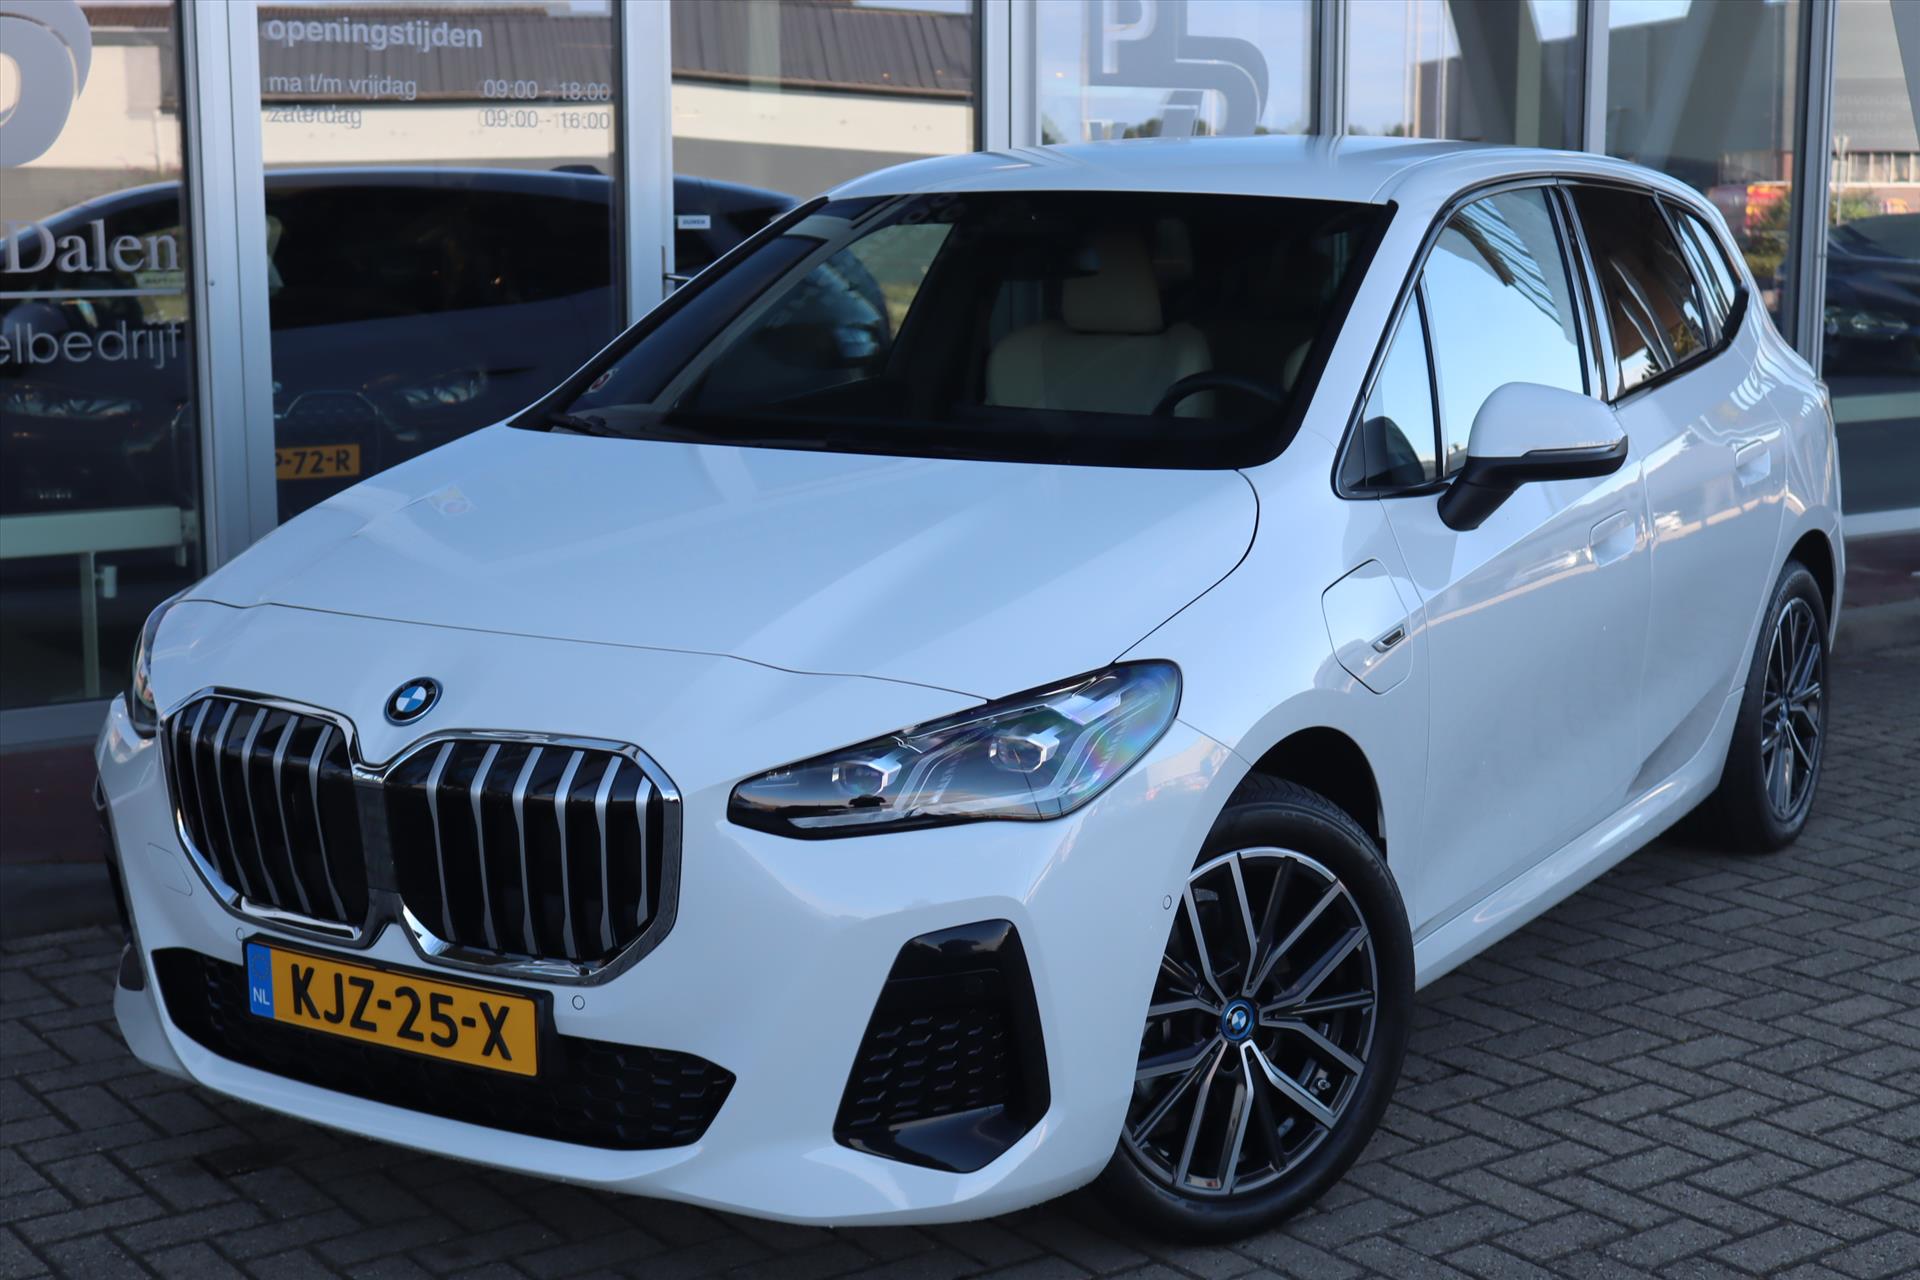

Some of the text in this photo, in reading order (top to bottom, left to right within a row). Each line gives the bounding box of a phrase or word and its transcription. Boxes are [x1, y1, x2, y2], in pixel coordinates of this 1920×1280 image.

[265, 17, 483, 52] openingstijden
[268, 75, 302, 92] ma
[309, 73, 342, 93] t/m
[348, 74, 417, 101] vrijdag
[483, 79, 538, 99] 09:00
[559, 81, 611, 101] 18:00
[267, 104, 362, 129] zaterdag
[483, 108, 538, 128] 09:00
[559, 111, 611, 129] 16:00
[4, 218, 180, 273] Dalen
[253, 986, 270, 1006] NL
[291, 963, 512, 1061] KJZ-25-X
